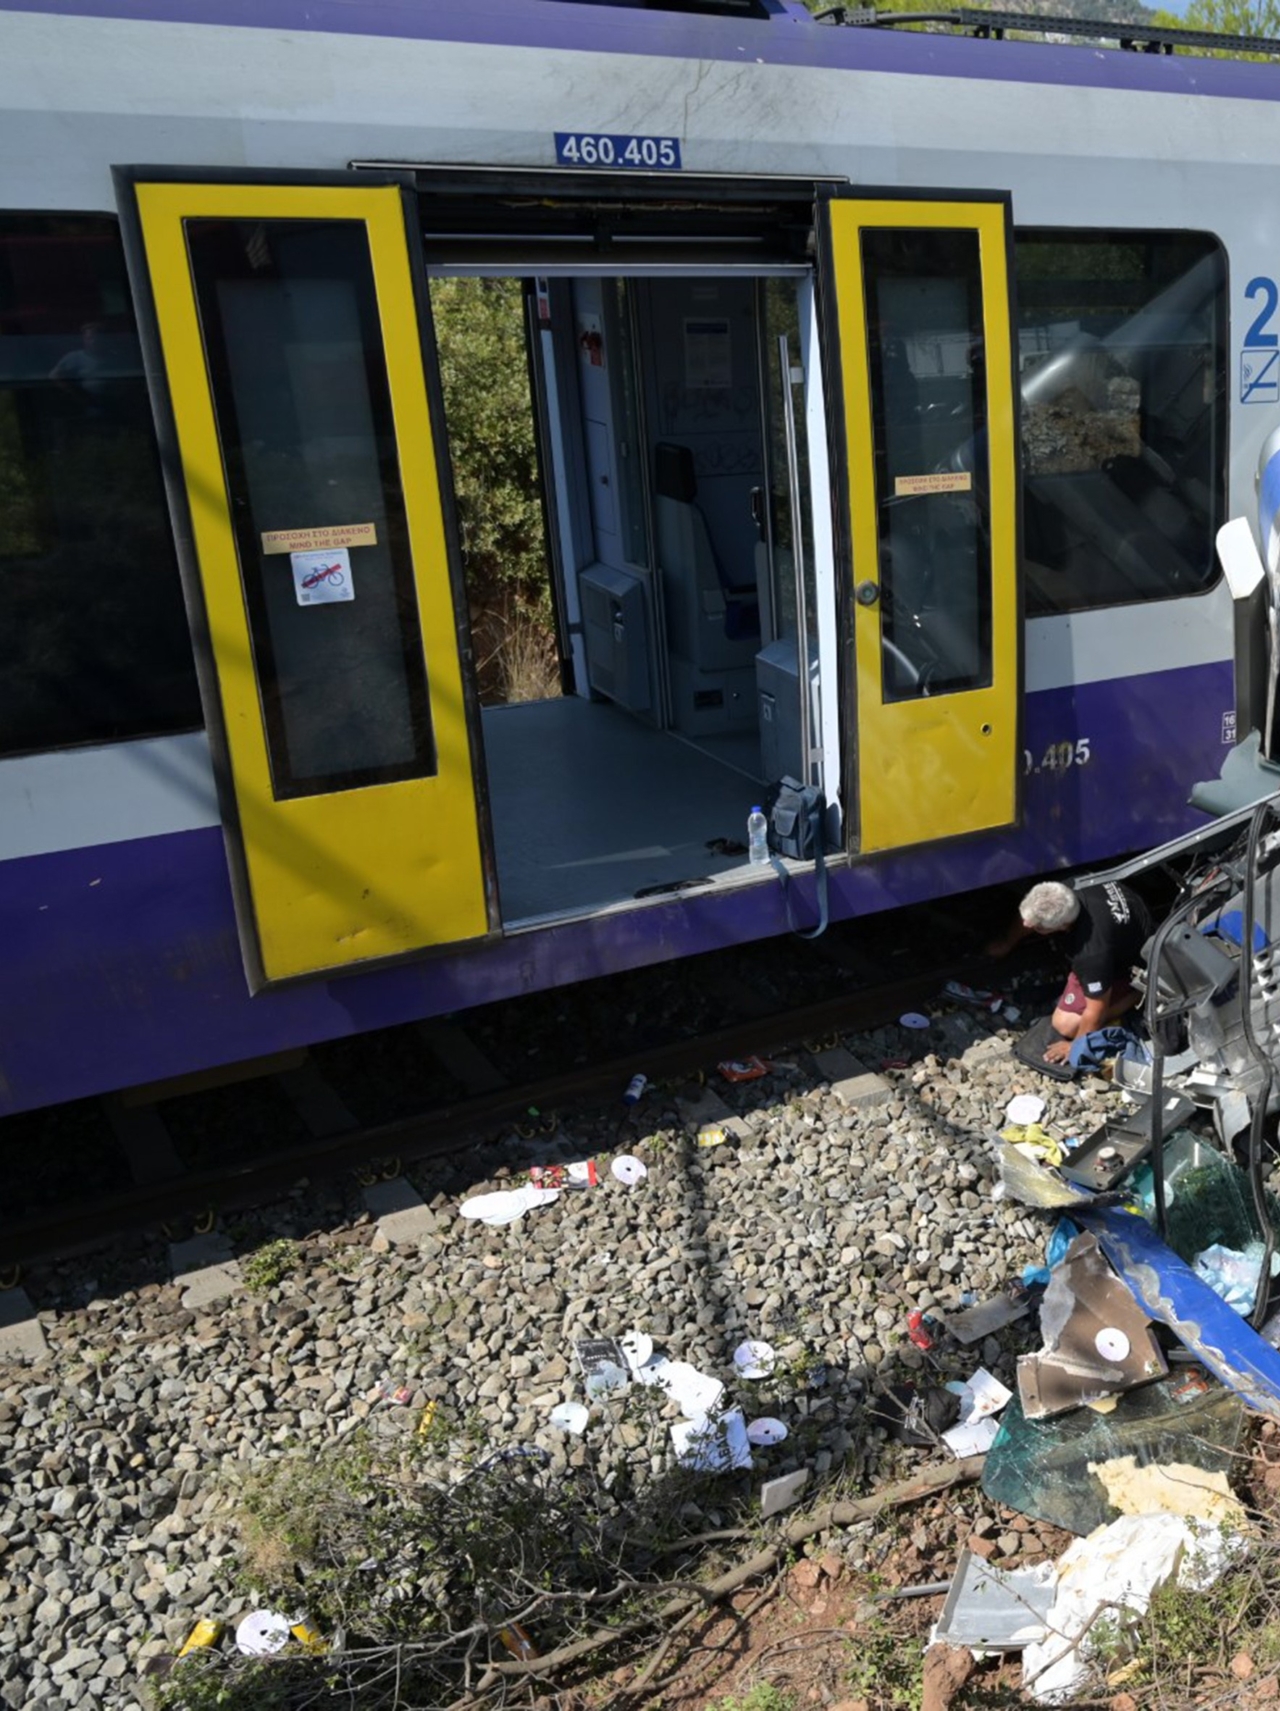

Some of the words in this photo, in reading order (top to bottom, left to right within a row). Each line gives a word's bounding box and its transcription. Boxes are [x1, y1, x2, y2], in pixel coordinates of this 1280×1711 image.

[562, 136, 675, 165] 460.405
[1243, 276, 1278, 347] 2
[266, 530, 311, 543] ΠΡΟΣΟΧΗ
[312, 529, 330, 538] ΣΤΟ
[331, 526, 371, 537] ΔΙΑΚΕΝΟ
[289, 540, 312, 549] MIND
[314, 539, 332, 547] THE
[333, 537, 353, 546] GAP
